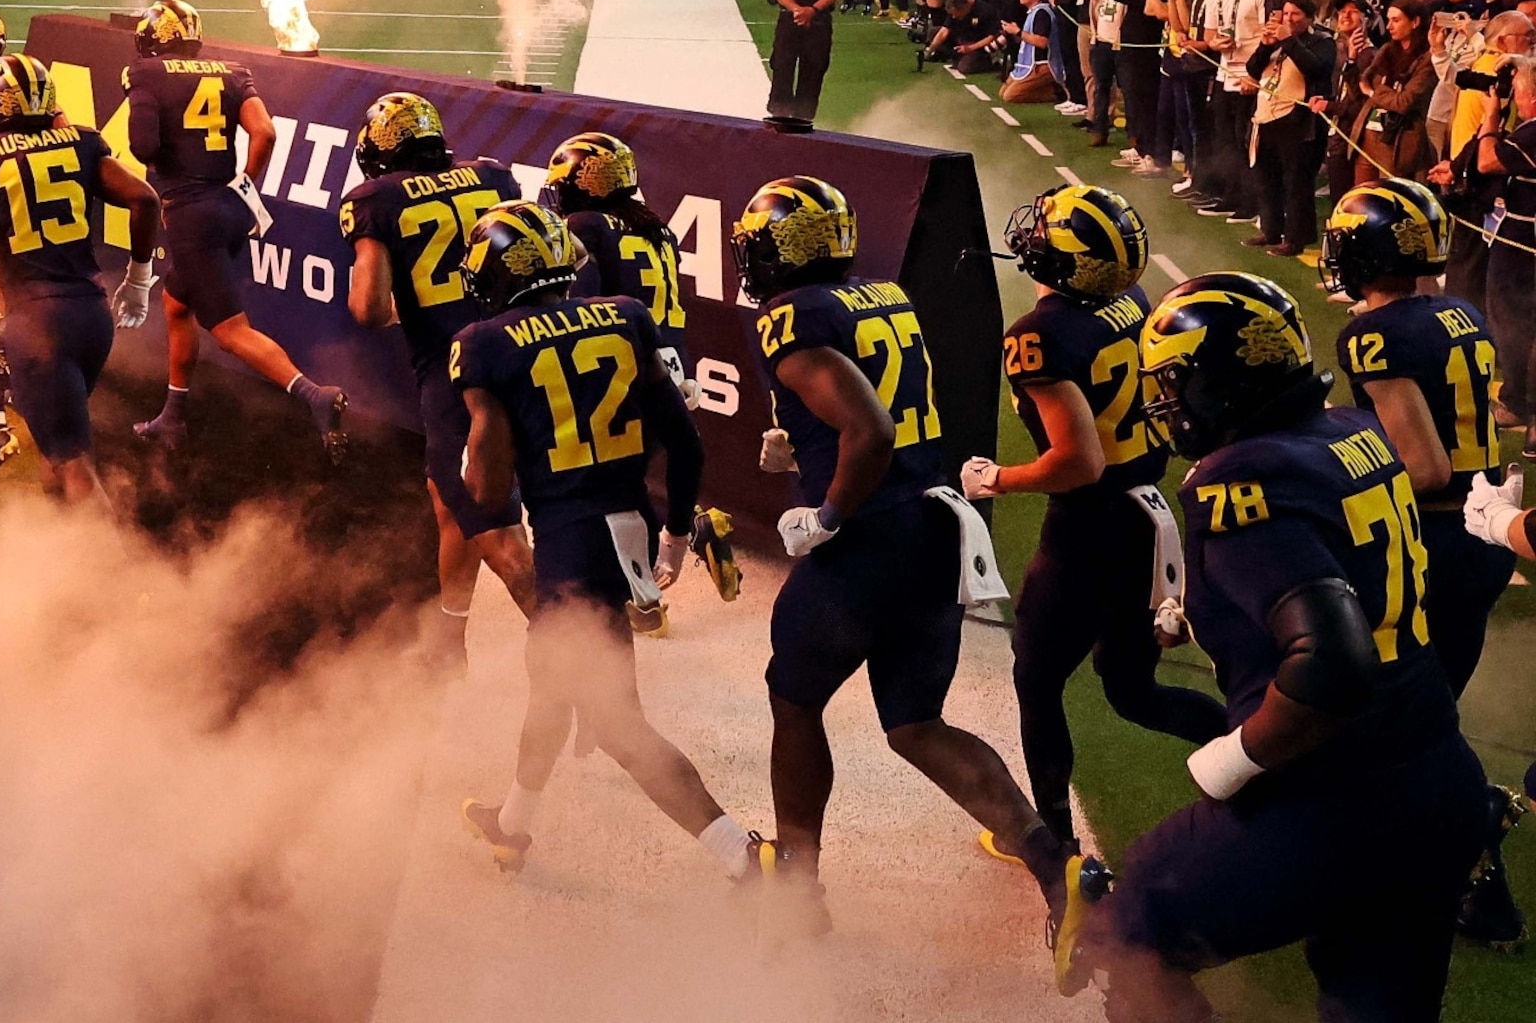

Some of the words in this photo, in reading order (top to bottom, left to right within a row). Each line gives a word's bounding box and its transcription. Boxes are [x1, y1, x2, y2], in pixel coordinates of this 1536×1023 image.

[162, 59, 232, 76] DENEGAL
[183, 76, 228, 153] 4
[399, 166, 483, 200] COLSON
[617, 235, 686, 329] 31
[504, 302, 627, 348] WALLACE
[756, 303, 796, 359] 27
[1434, 307, 1480, 340] BELL
[854, 310, 942, 450] 27
[1003, 331, 1044, 376] 26
[1346, 332, 1389, 374] 12
[529, 333, 644, 474] 12
[1445, 338, 1501, 474] 12
[1196, 480, 1270, 534] 78
[1342, 468, 1430, 663] 78
